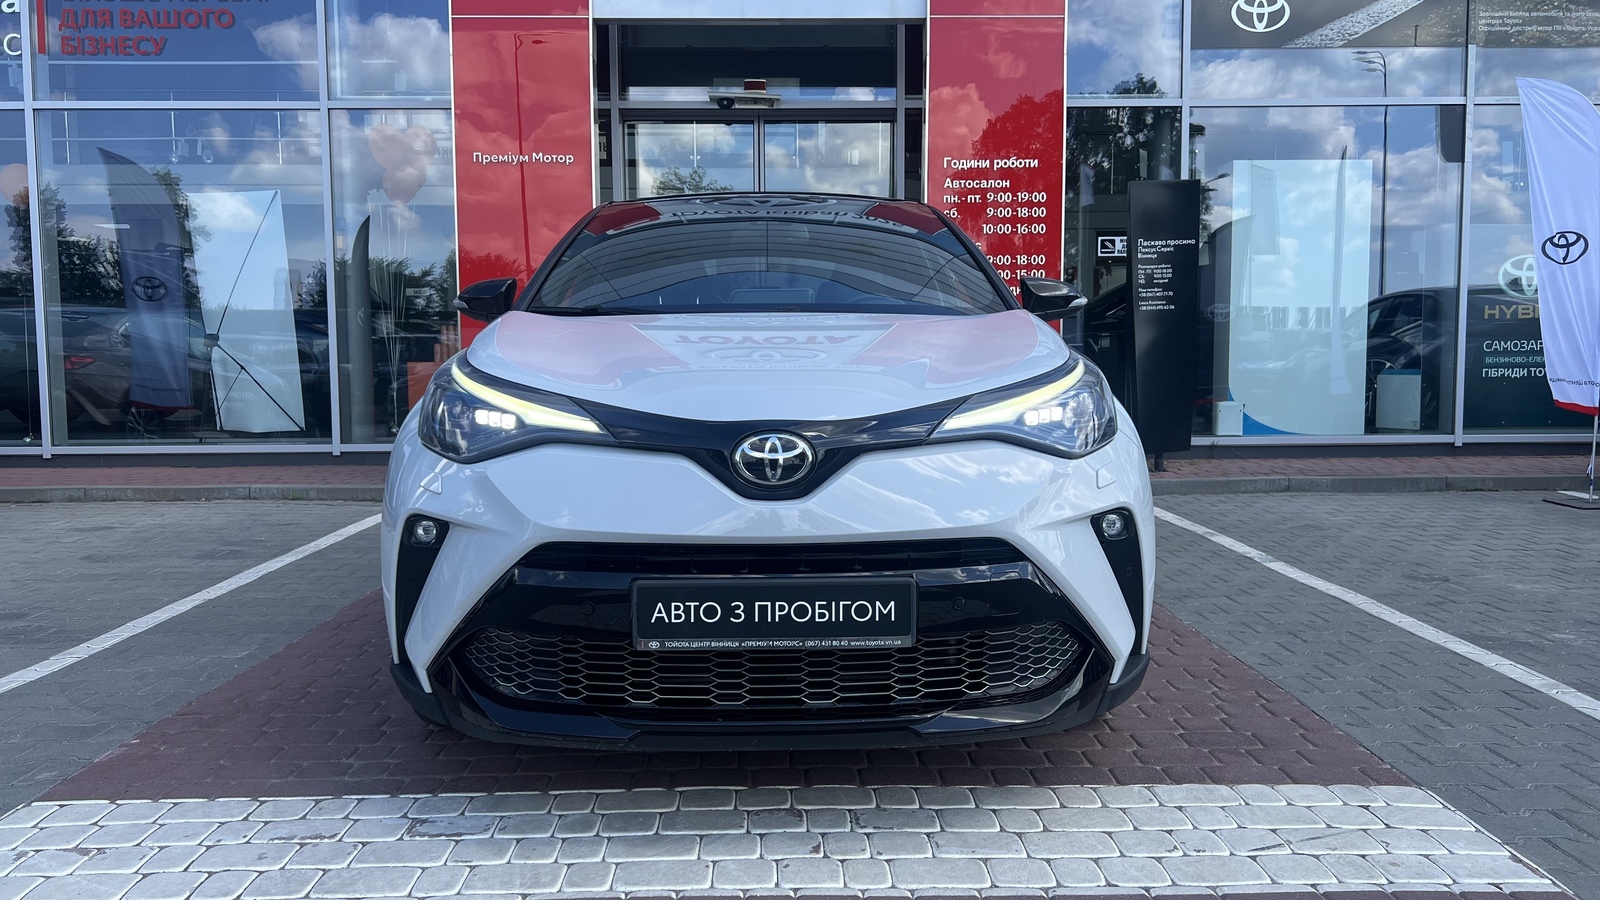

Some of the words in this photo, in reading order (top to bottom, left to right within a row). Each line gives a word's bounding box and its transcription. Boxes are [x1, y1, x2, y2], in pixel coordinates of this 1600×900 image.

[59, 8, 111, 30] ДЛЯ
[119, 8, 234, 29] ВАШОГО
[61, 35, 166, 56] БІЗНЕСУ
[473, 152, 529, 165] Преміум
[532, 152, 574, 165] Мотор
[944, 158, 990, 170] Години
[994, 157, 1038, 170] роботи
[944, 178, 1010, 188] Автосалон
[944, 208, 960, 218] сб.
[987, 207, 1046, 217] 9:00-18:00
[982, 224, 1046, 234] 10:00-16:00
[1484, 305, 1540, 319] HYB
[1484, 340, 1544, 351] САМОЗАР
[1483, 368, 1528, 378] ГІБРИДИ
[651, 602, 722, 623] АВТО
[755, 600, 895, 622] ПРОБІГОМ
